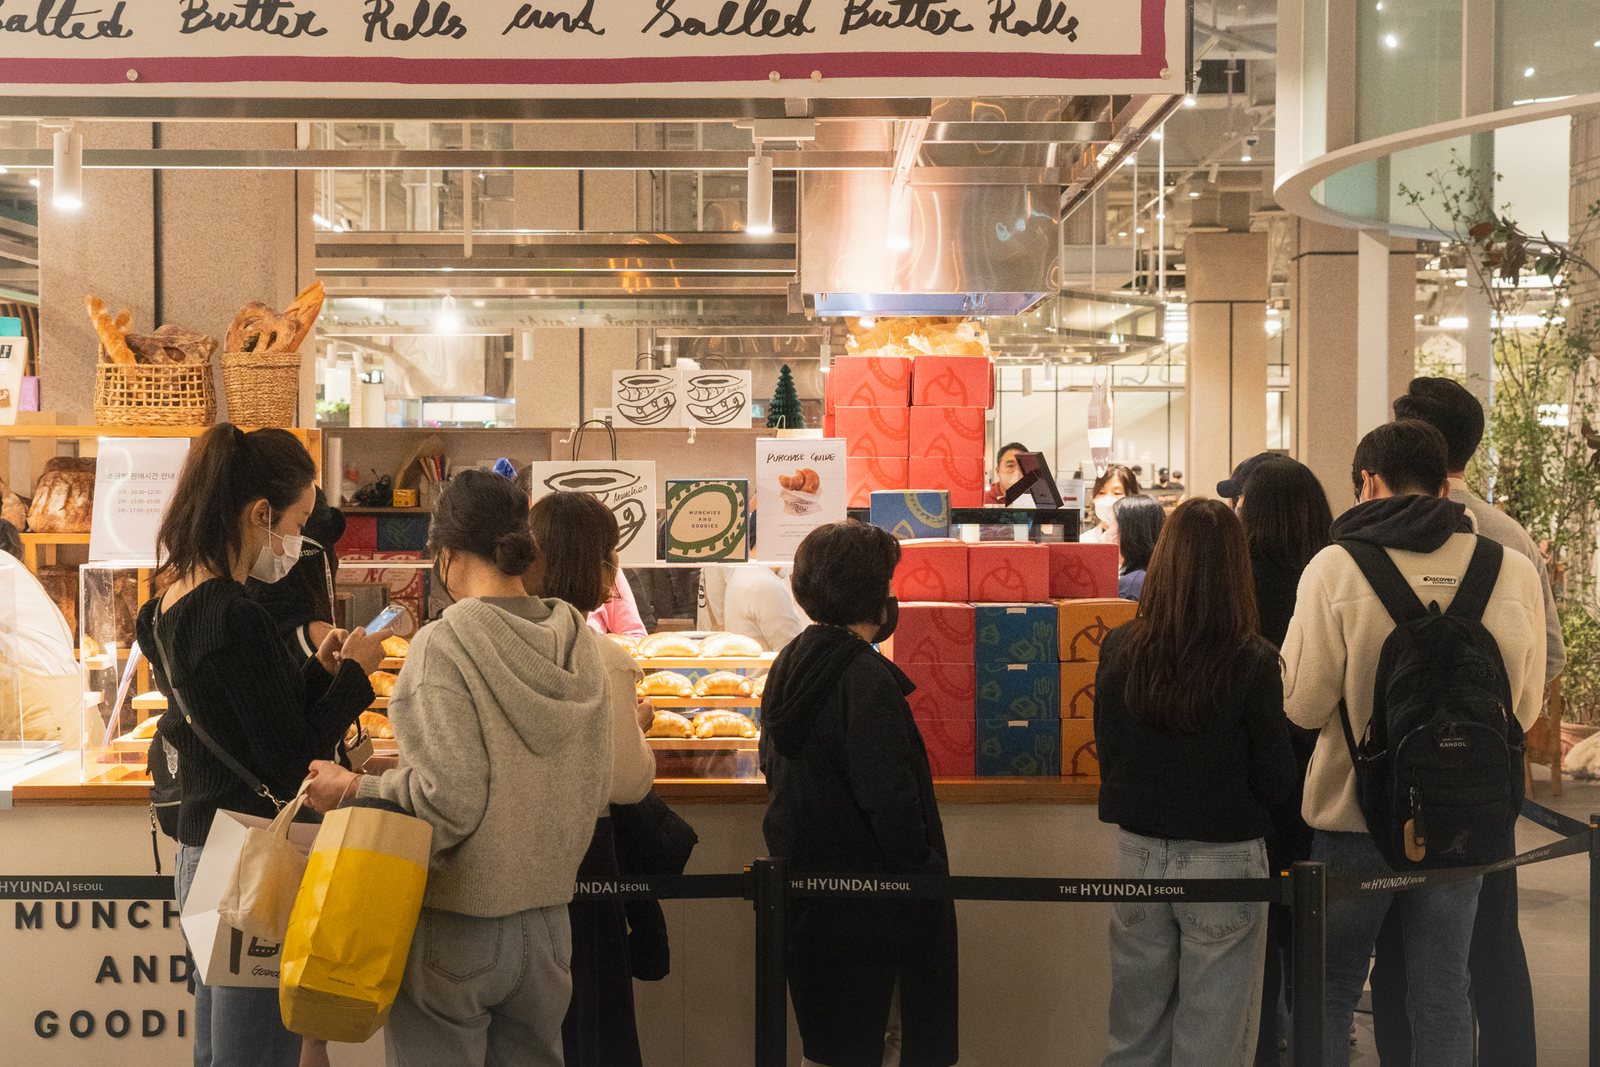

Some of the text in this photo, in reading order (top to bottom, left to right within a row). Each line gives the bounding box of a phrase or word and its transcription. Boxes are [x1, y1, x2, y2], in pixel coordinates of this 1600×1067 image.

[0, 0, 133, 39] alted
[179, 0, 328, 38] Butter
[363, 0, 467, 42] Rolls
[501, 0, 605, 35] and
[840, 0, 974, 36] Butter
[766, 452, 836, 463] PURCHASE GUIDE
[72, 883, 104, 891] SEOUL
[574, 881, 651, 894] NDAI SEOUL
[790, 878, 911, 891] HE HYUNDAI SEOUL
[1371, 876, 1411, 889] HYUNDAI
[1060, 883, 1185, 896] THE HYUNDAI SEOUL
[95, 955, 189, 983] AND
[34, 1009, 185, 1038] GOODI
